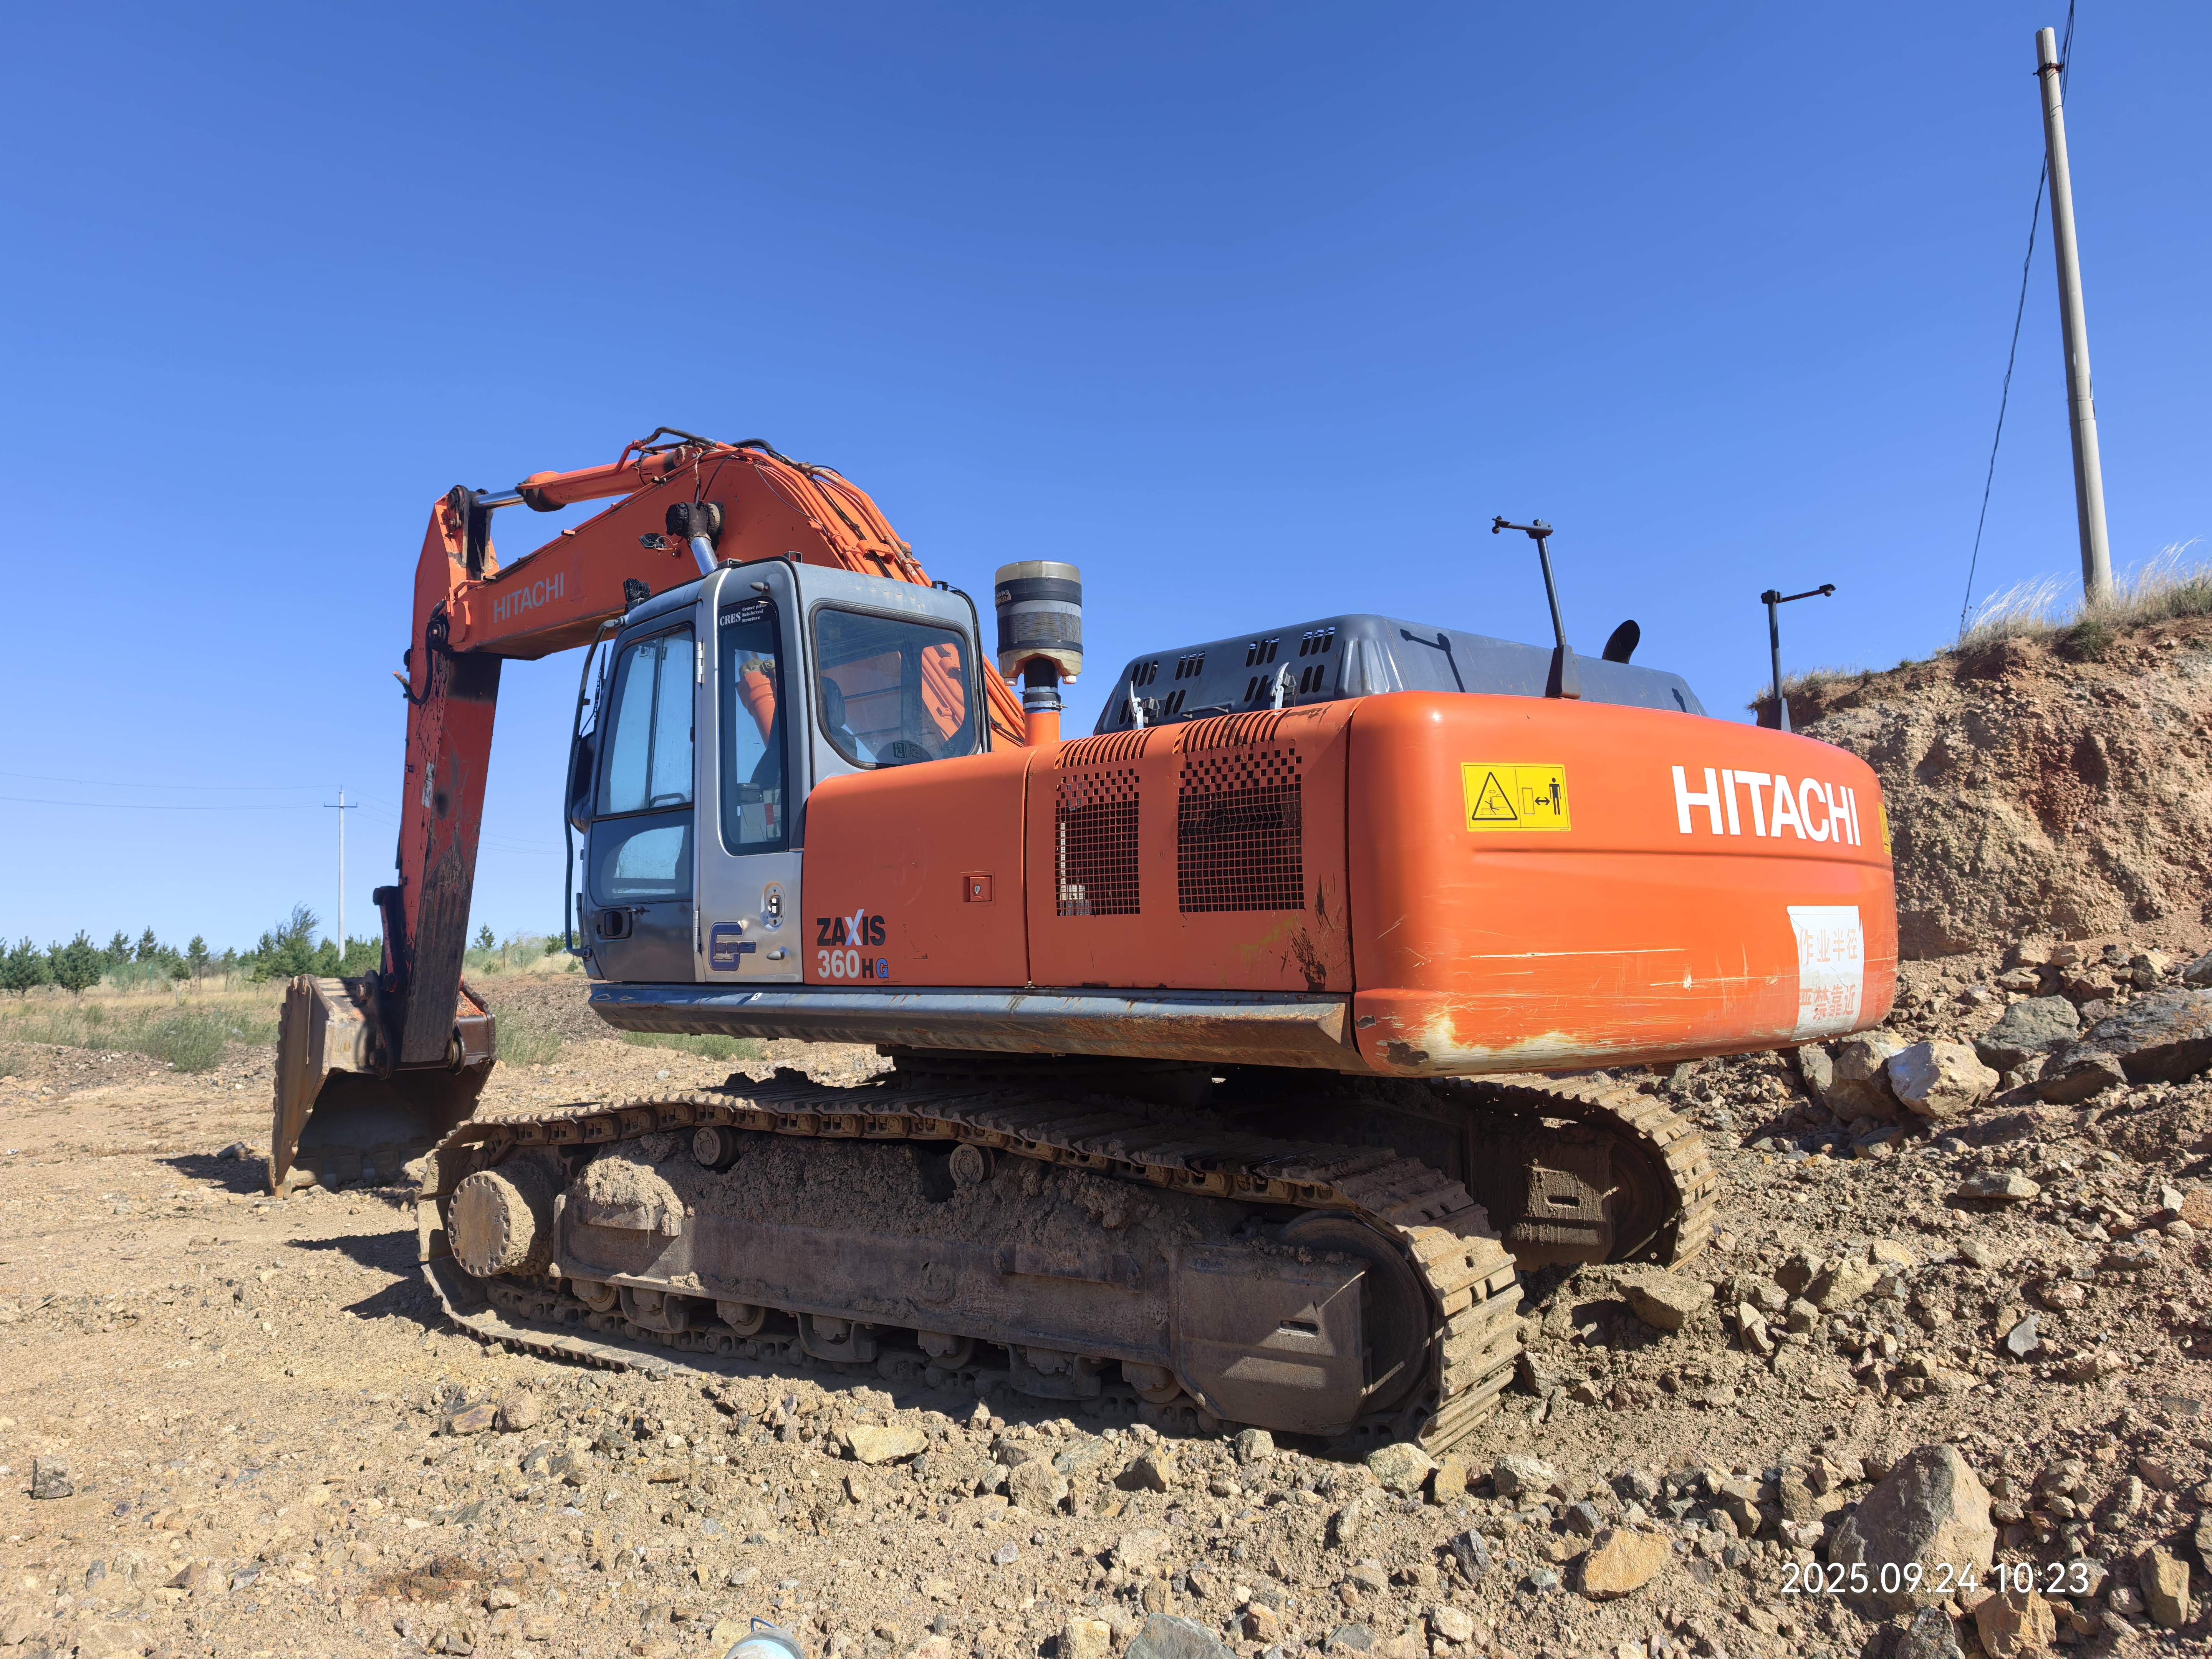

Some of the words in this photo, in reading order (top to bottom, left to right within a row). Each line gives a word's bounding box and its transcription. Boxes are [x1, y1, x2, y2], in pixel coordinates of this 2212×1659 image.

[493, 571, 564, 623] HITACHI
[720, 612, 741, 626] CRES
[1672, 765, 1861, 846] HITACHI
[816, 909, 886, 946] ZAXIS
[1799, 928, 1858, 965] 作业半径
[1799, 983, 1856, 1020] 严禁靠近
